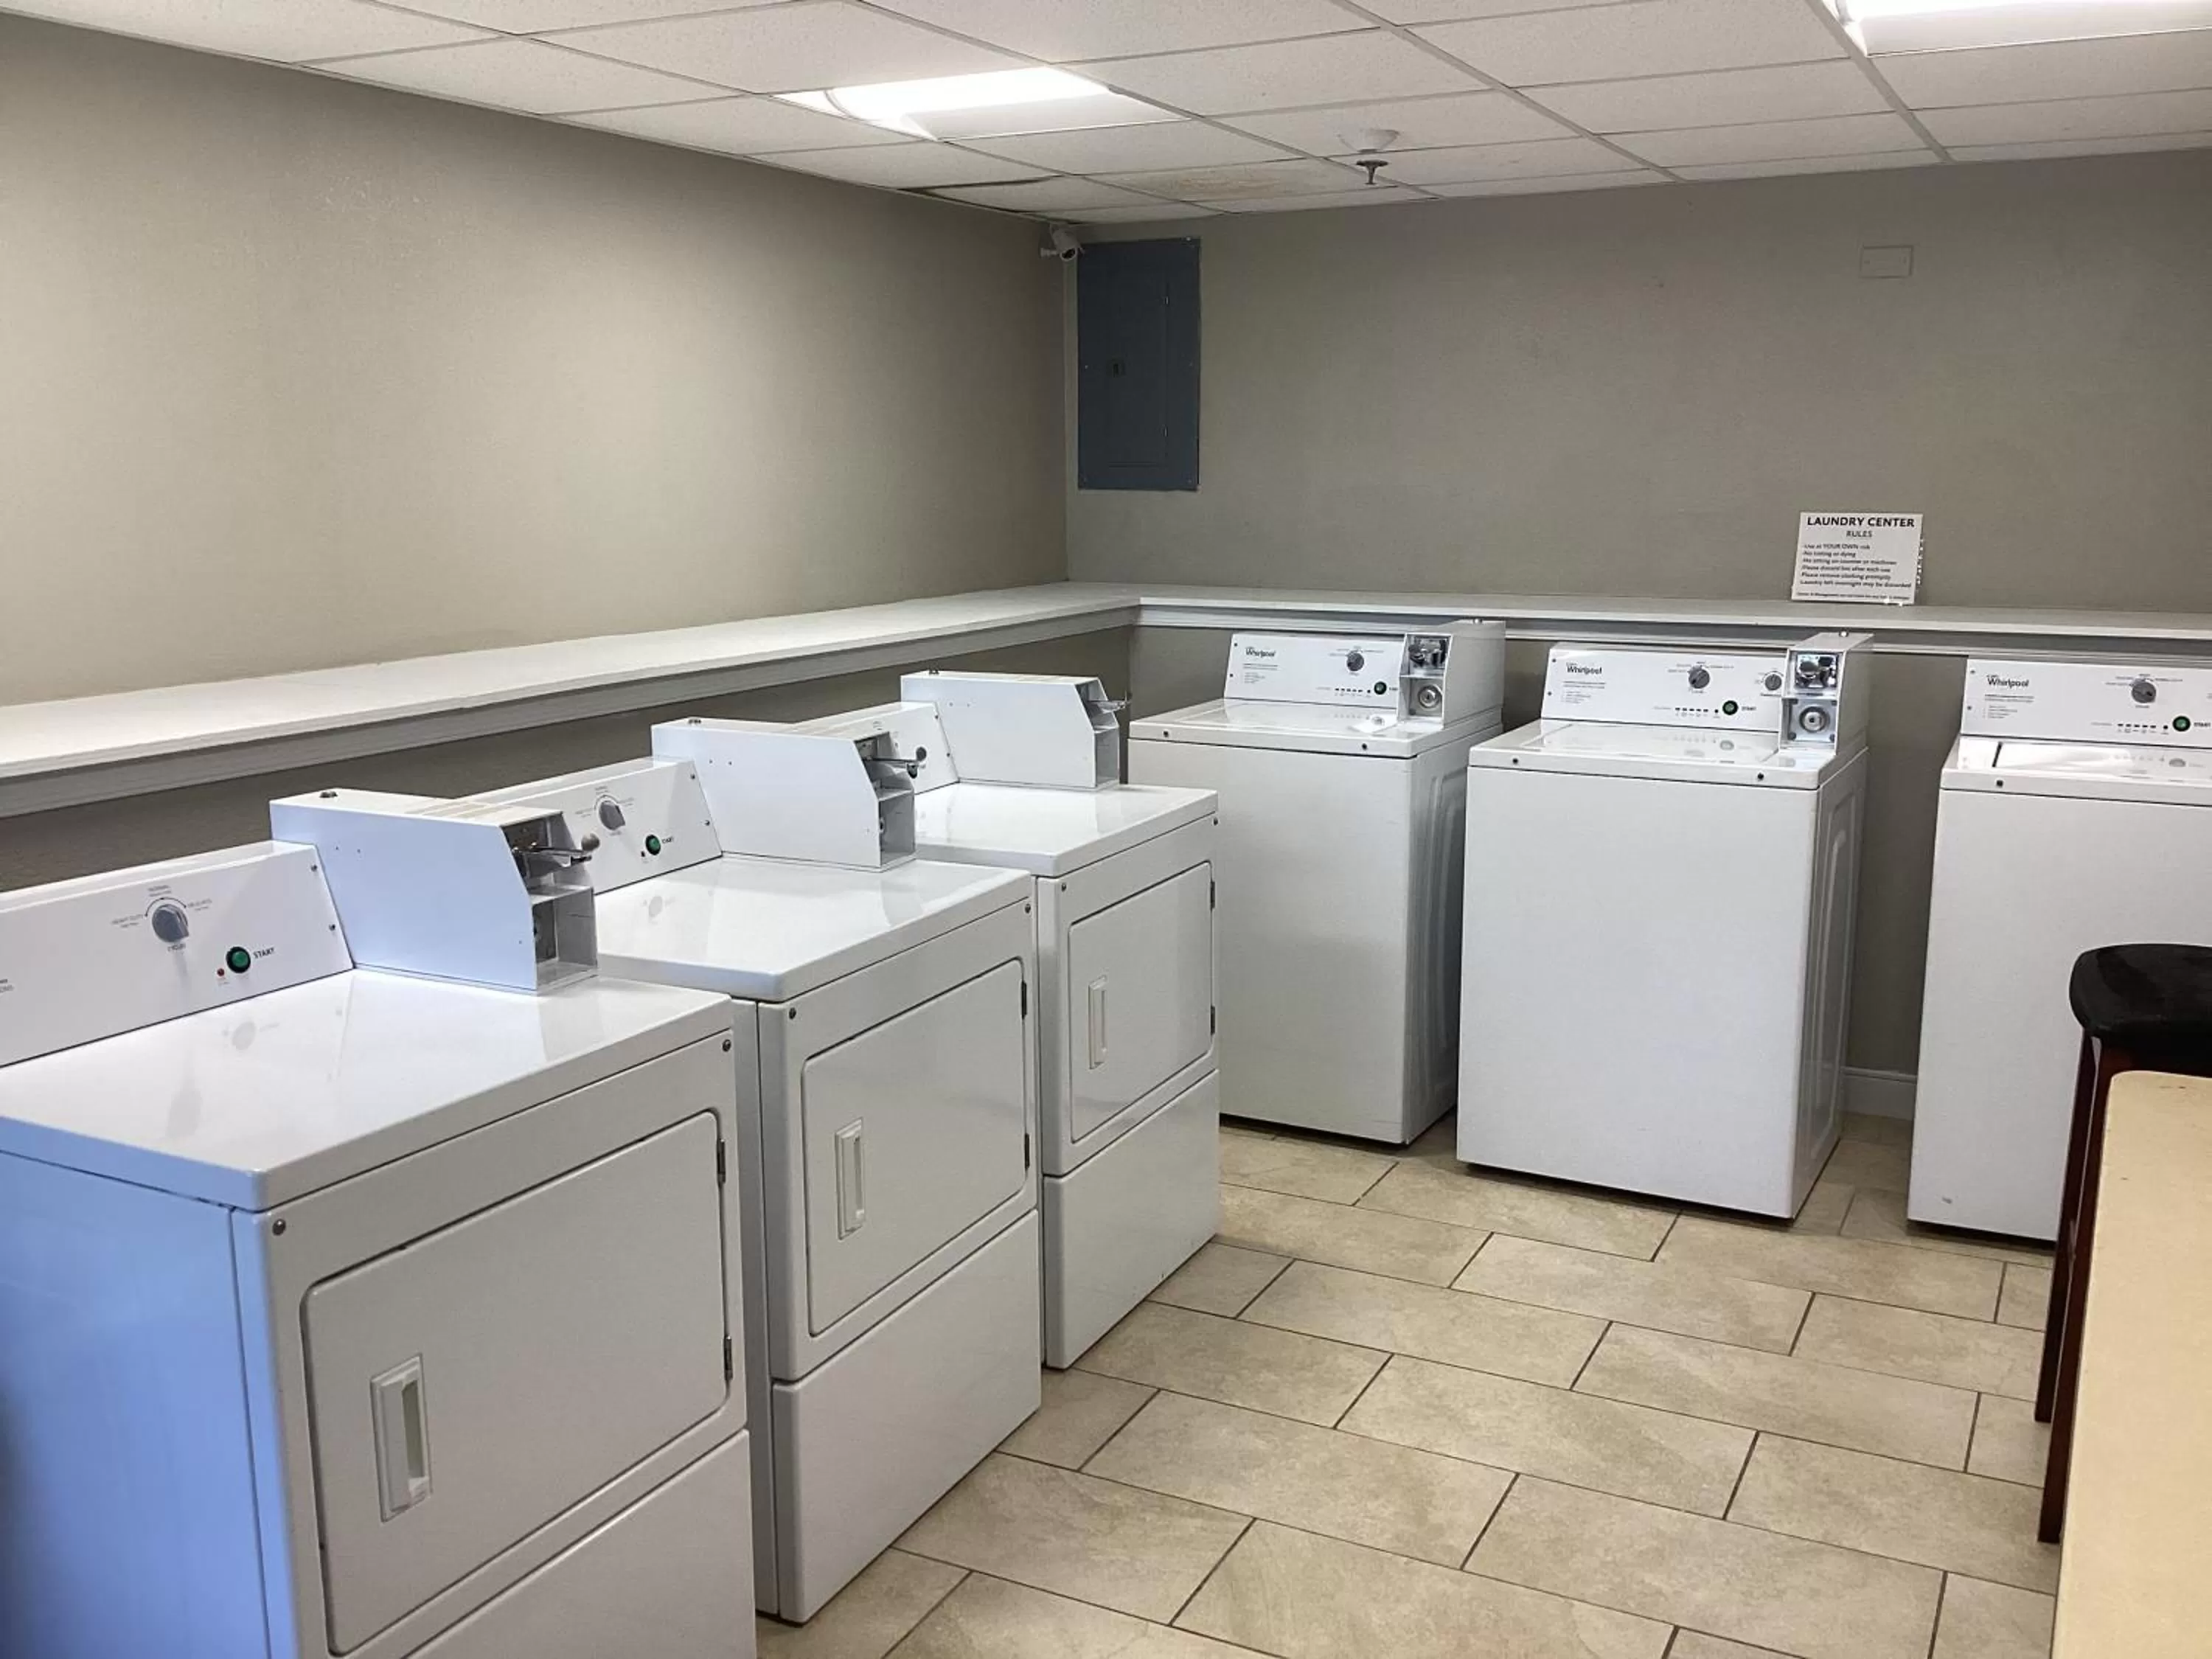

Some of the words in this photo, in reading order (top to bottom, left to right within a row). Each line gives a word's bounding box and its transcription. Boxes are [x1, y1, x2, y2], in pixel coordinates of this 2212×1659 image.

[1807, 517, 1865, 526] LAUNDRY
[1868, 518, 1915, 527] CENTER
[1245, 648, 1277, 658] Whirlpool
[1567, 665, 1603, 676] Whirlpool
[1987, 676, 2030, 689] Whirlpool
[253, 947, 275, 959] START
